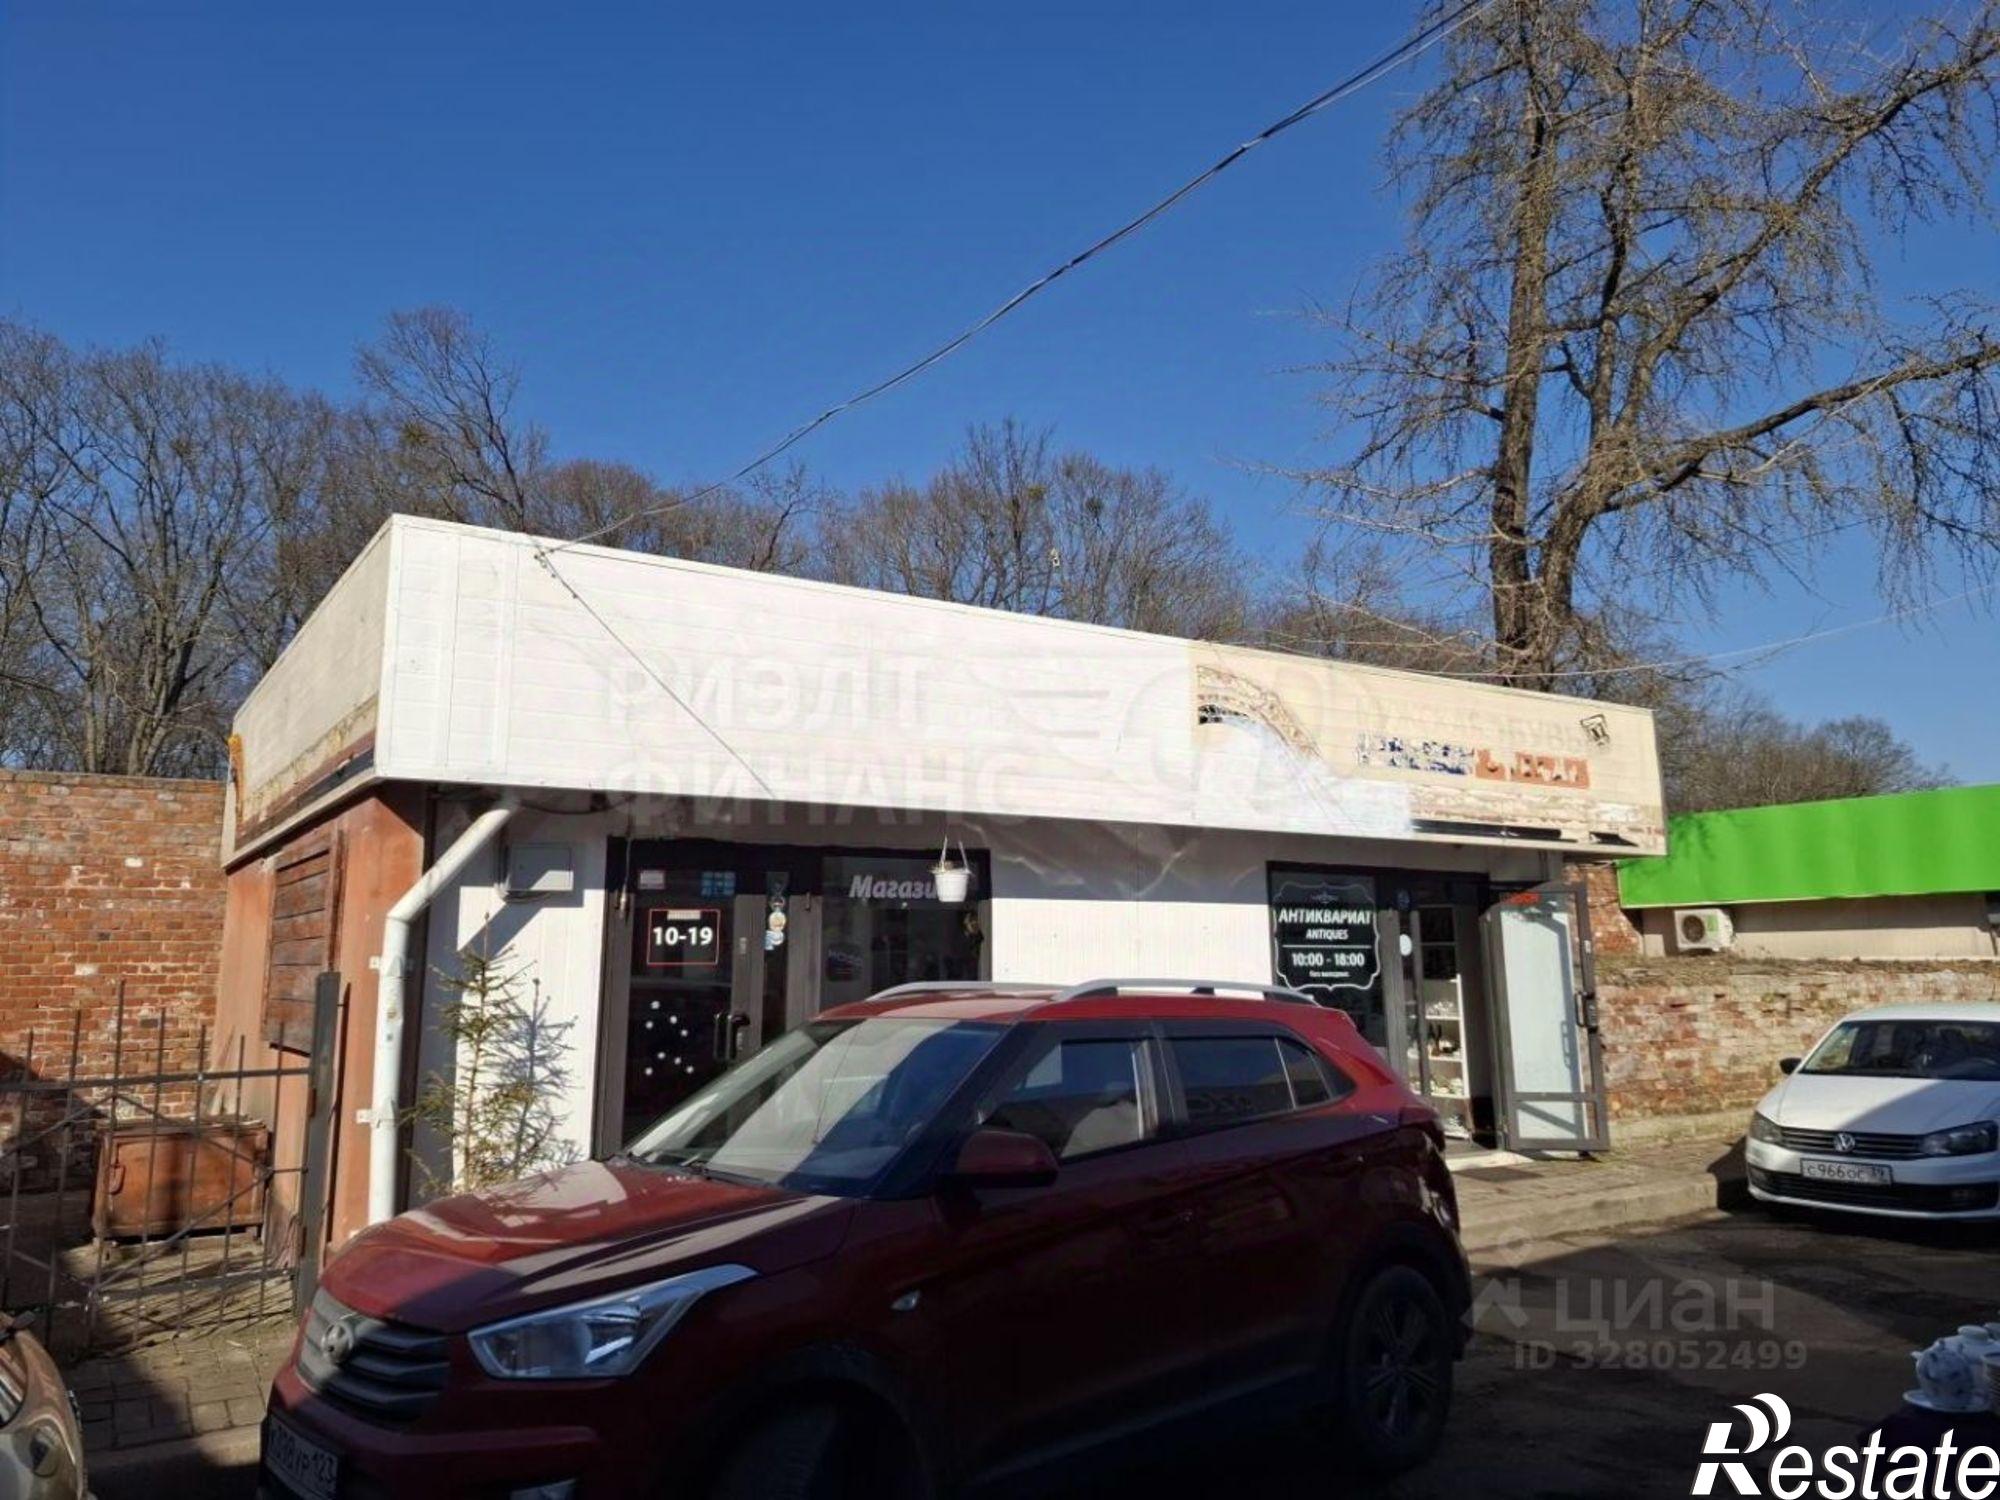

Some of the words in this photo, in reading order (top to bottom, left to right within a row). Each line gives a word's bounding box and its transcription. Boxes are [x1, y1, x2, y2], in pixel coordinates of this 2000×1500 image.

[848, 874, 938, 899] Магази
[1278, 907, 1372, 925] АНТИКВАРИАТ
[652, 925, 714, 946] 10-19
[1305, 928, 1350, 941] ANTIQUES
[1291, 952, 1324, 967] 10:00
[1334, 952, 1365, 967] 18:00
